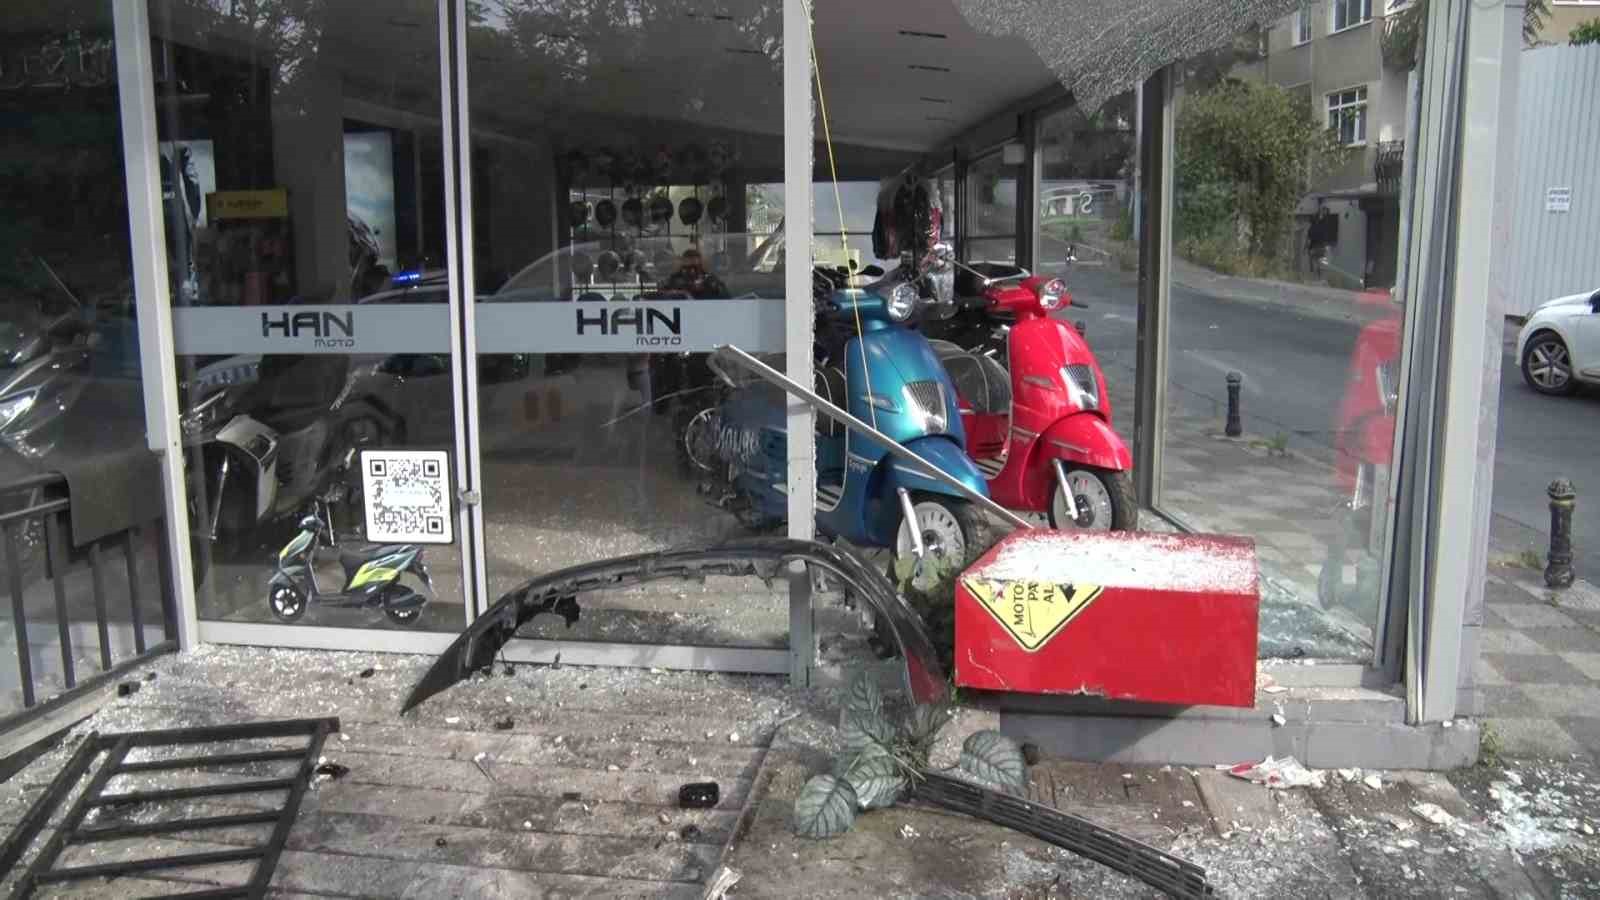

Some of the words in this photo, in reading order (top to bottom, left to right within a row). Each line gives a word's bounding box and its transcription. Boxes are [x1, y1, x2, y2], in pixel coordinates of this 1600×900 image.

[262, 311, 354, 337] HAN
[576, 307, 681, 335] HAN
[314, 339, 355, 348] MOTO
[636, 336, 682, 345] MOTO
